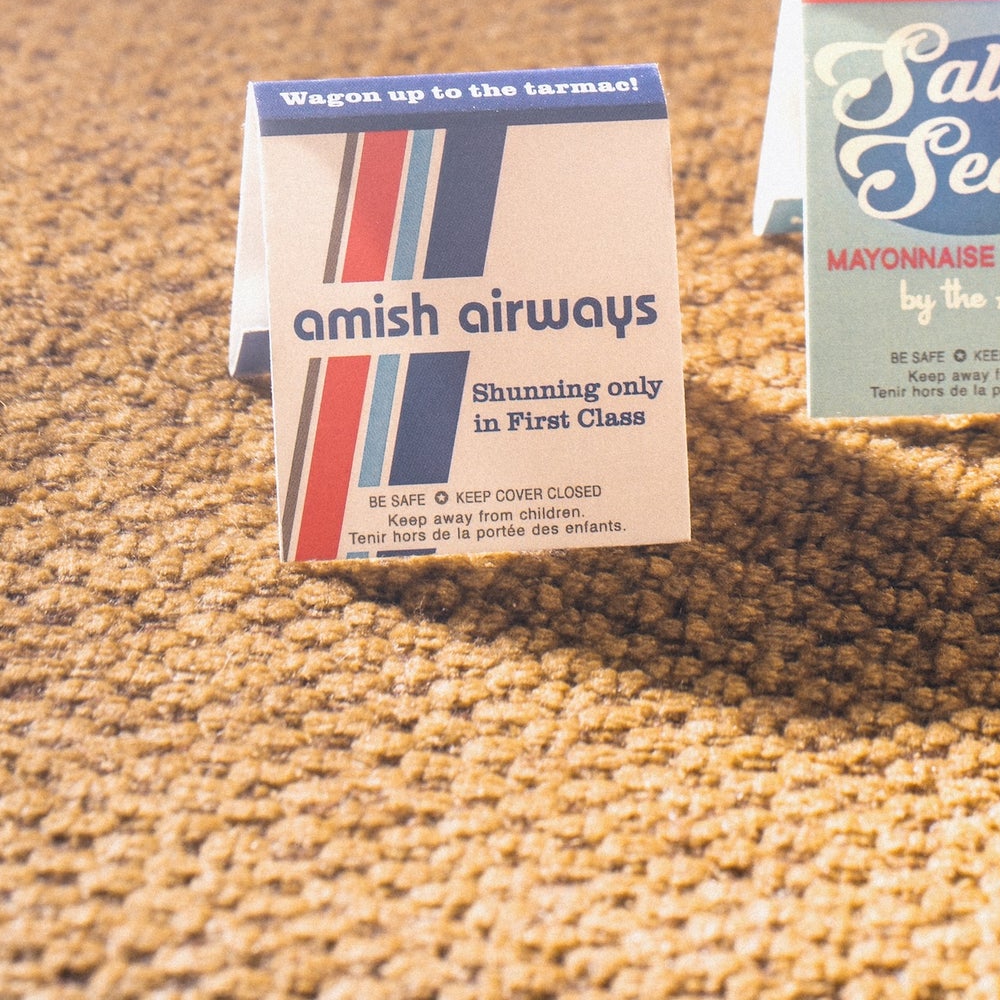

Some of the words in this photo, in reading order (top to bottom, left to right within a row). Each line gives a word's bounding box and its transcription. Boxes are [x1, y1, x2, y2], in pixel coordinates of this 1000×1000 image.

[280, 90, 382, 108] Wagon
[388, 89, 425, 104] up
[431, 86, 462, 100] to
[468, 83, 517, 98] the
[524, 77, 640, 95] tarmac!
[827, 245, 995, 271] MAYONNAISE
[900, 278, 936, 326] by
[940, 276, 988, 310] the
[293, 291, 439, 341] amish
[459, 288, 658, 339] airways
[890, 351, 908, 364] BE
[912, 350, 945, 363] SAFE
[472, 379, 601, 403] Shunning
[608, 376, 663, 400] only
[908, 370, 946, 384] Keep
[951, 371, 989, 383] away
[869, 386, 906, 399] Tenir
[912, 385, 945, 398] hors
[951, 384, 968, 397] de
[973, 384, 987, 396] la
[474, 414, 501, 433] in
[507, 410, 570, 431] First
[577, 408, 646, 428] Class
[369, 496, 386, 508] BE
[391, 494, 426, 507] SAFE
[456, 490, 491, 504] KEEP
[496, 488, 543, 501] COVER
[547, 485, 602, 499] CLOSED
[388, 513, 427, 528] Keep
[433, 513, 473, 526] away
[478, 510, 513, 522] from
[519, 506, 585, 520] children.
[349, 531, 386, 545] Tenir
[393, 530, 426, 543] hors
[432, 528, 451, 541] de
[457, 527, 470, 540] la
[476, 525, 526, 541] portée
[532, 523, 559, 536] des
[565, 520, 627, 534] enfants.
